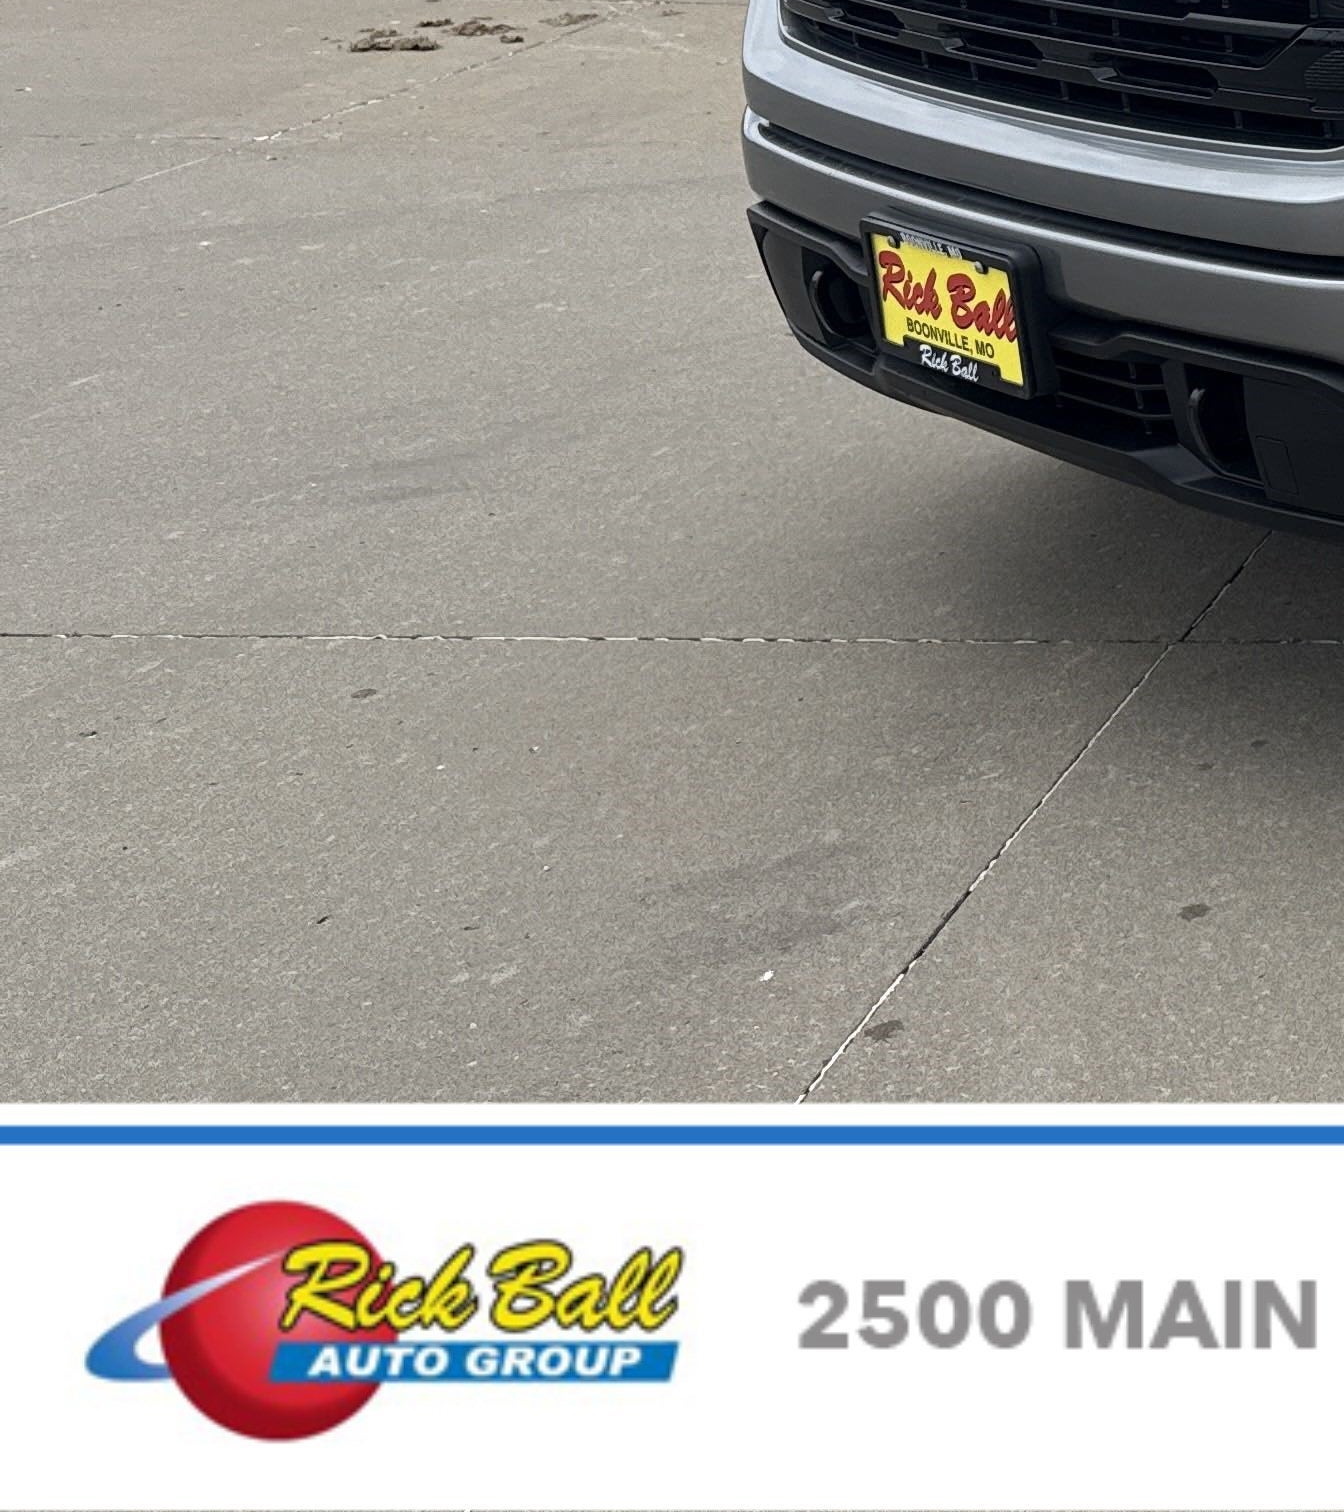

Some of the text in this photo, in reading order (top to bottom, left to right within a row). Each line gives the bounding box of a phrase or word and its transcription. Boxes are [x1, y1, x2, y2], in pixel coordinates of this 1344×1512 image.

[878, 250, 1018, 343] Rick Ball
[905, 316, 995, 359] BOONVILLE, MO
[919, 344, 980, 383] Rick Ball
